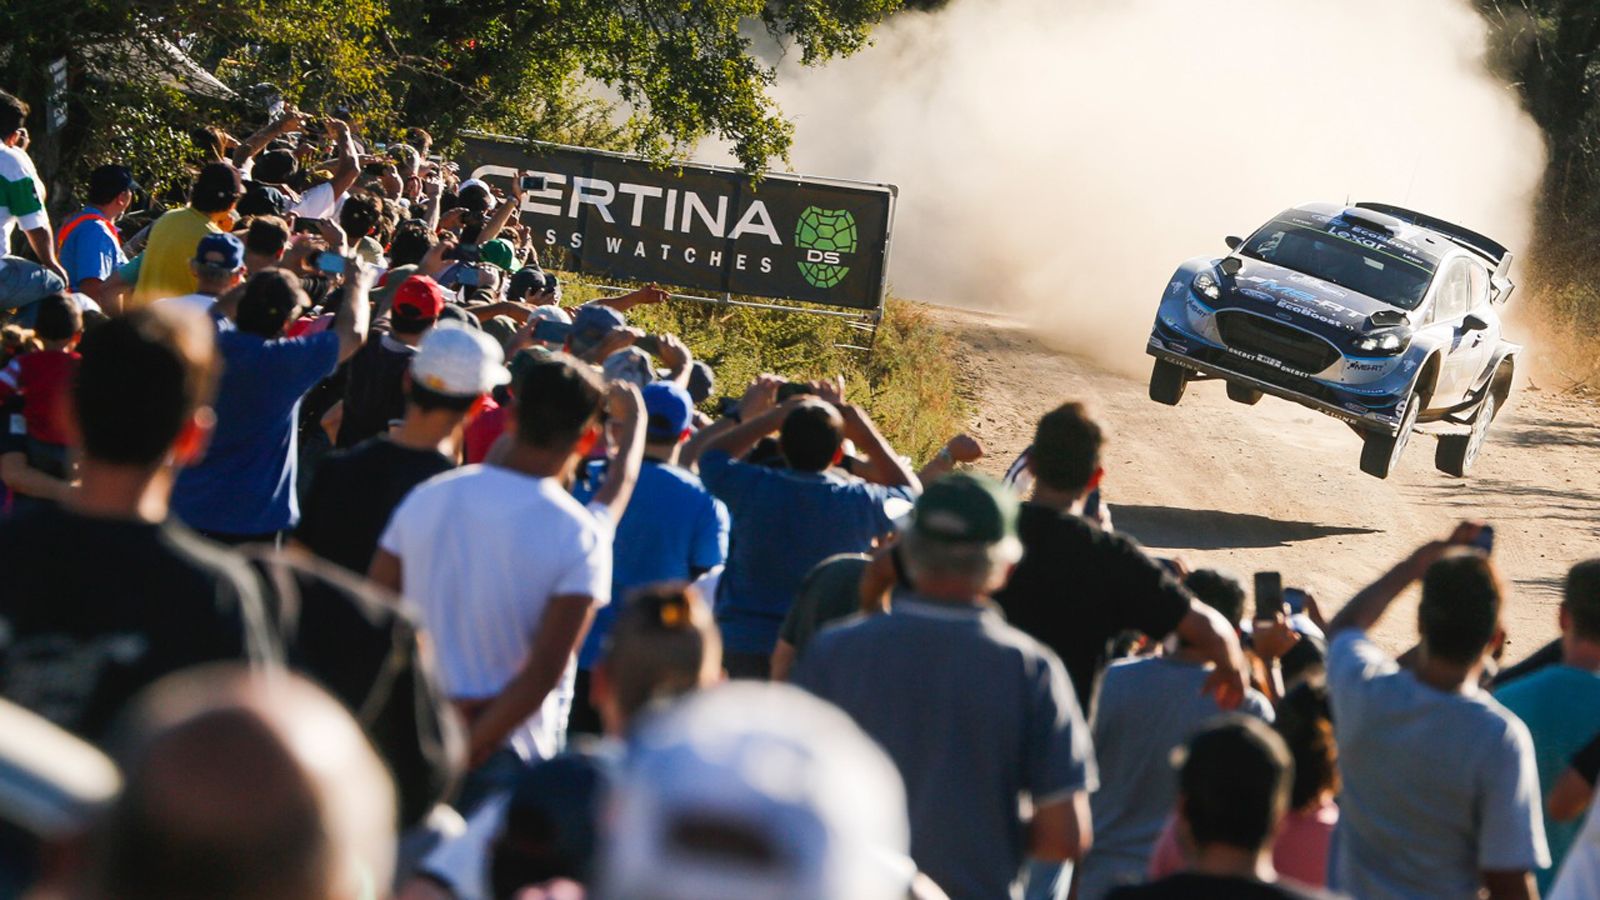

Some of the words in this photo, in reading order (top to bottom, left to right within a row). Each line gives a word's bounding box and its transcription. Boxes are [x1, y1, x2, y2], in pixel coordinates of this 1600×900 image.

[1328, 226, 1387, 250] Lexar
[1352, 225, 1418, 254] EcoBoost
[606, 237, 773, 274] WATCHES
[806, 248, 841, 265] DS
[1276, 300, 1342, 328] EcoBoost
